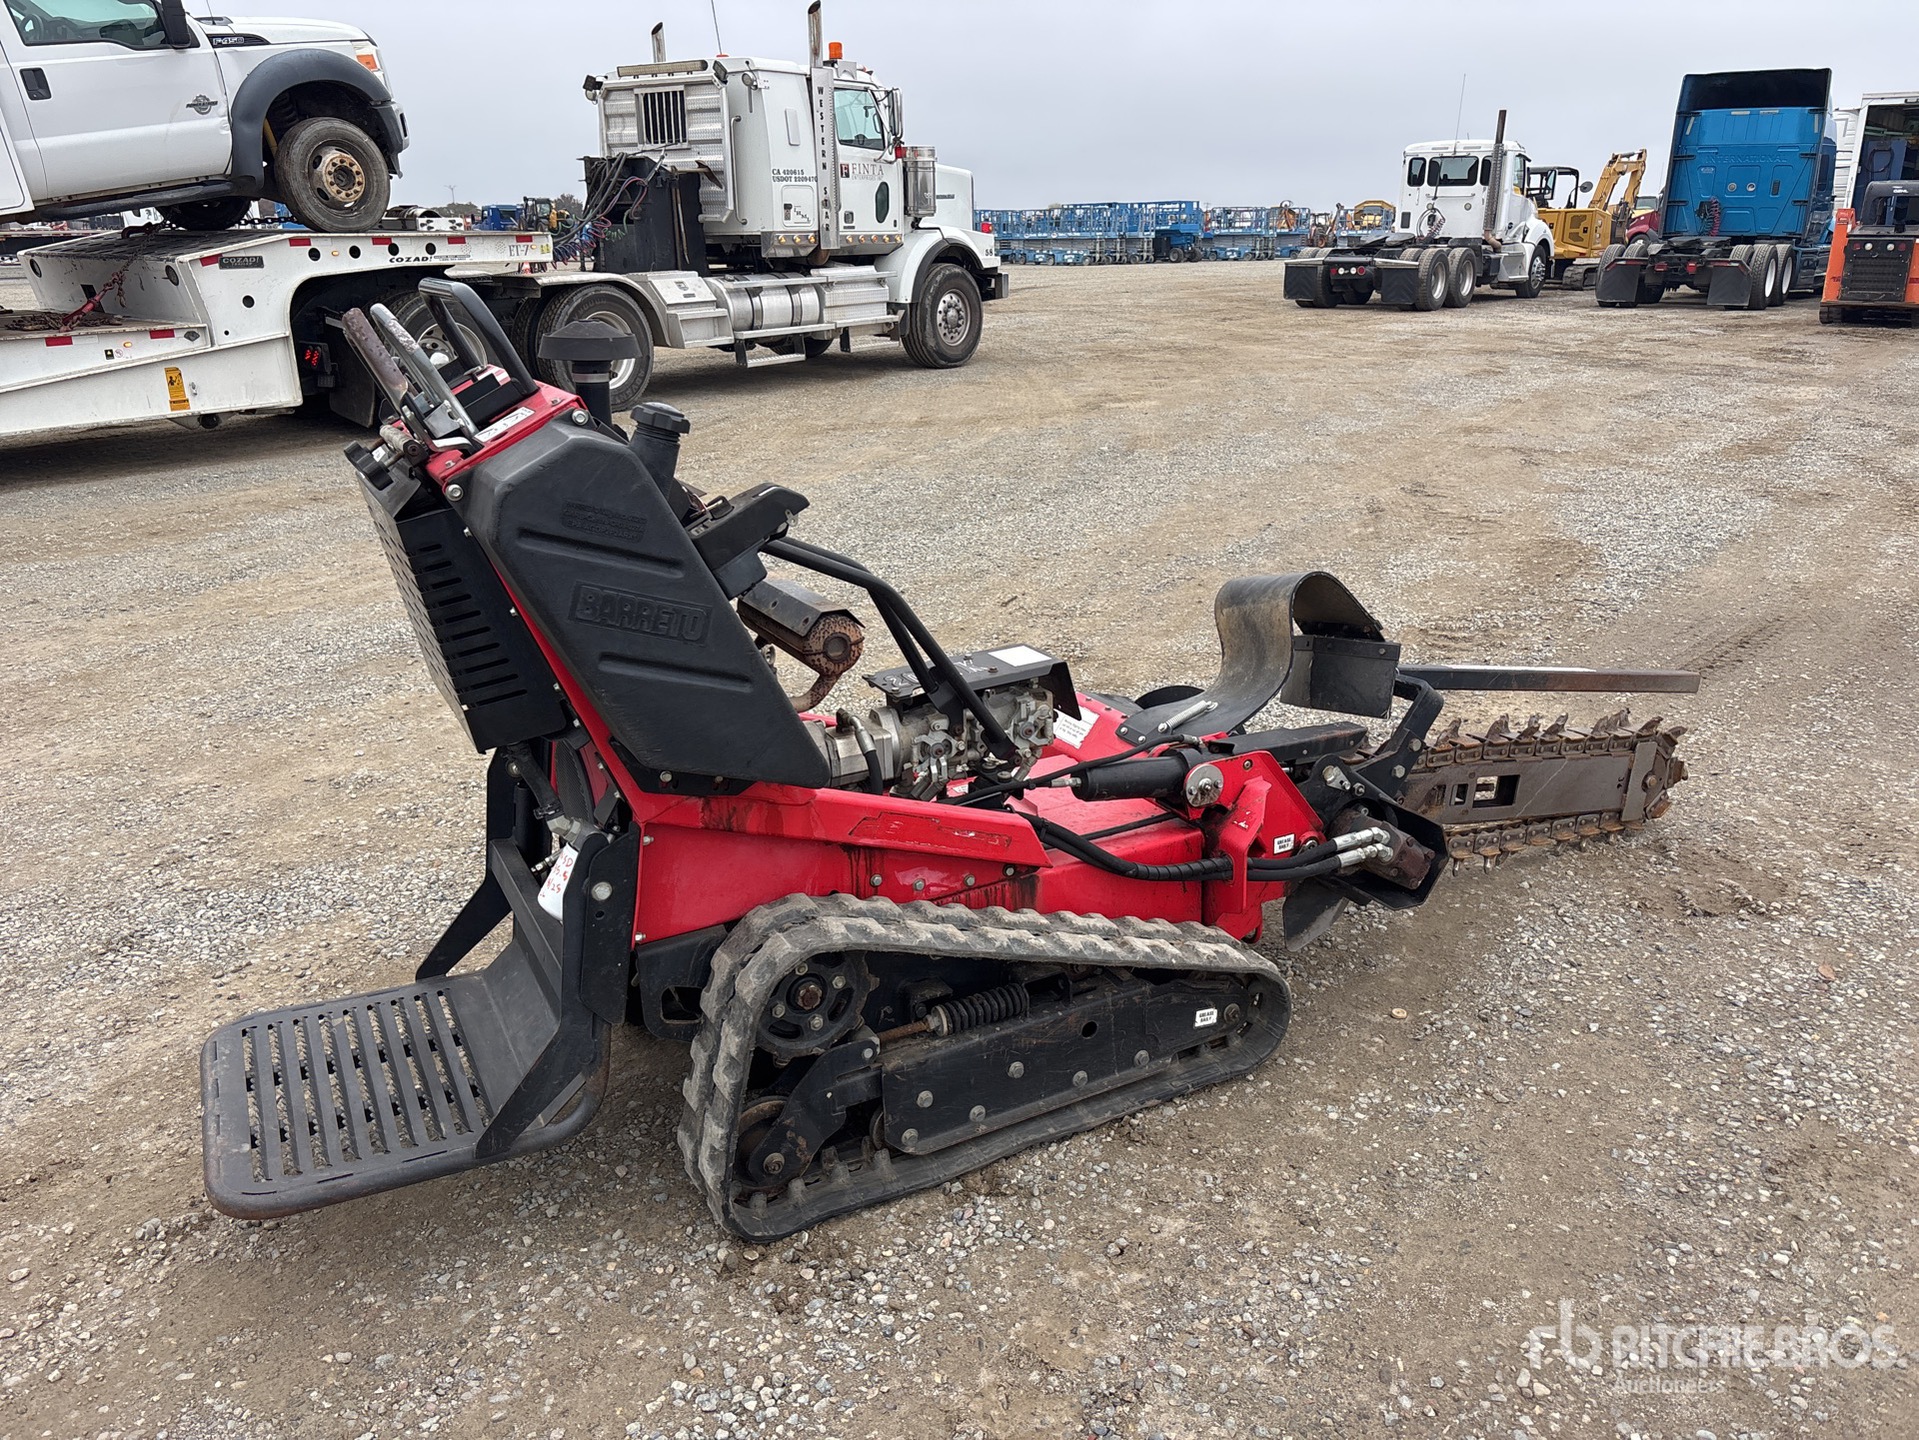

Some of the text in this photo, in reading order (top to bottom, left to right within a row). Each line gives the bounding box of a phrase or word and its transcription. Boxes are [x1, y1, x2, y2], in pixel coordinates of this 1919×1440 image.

[817, 86, 831, 232] WESTERN STAR
[851, 163, 885, 177] FINTA
[1703, 154, 1788, 164] INTERNATIONAL
[575, 585, 706, 641] BARRETO
